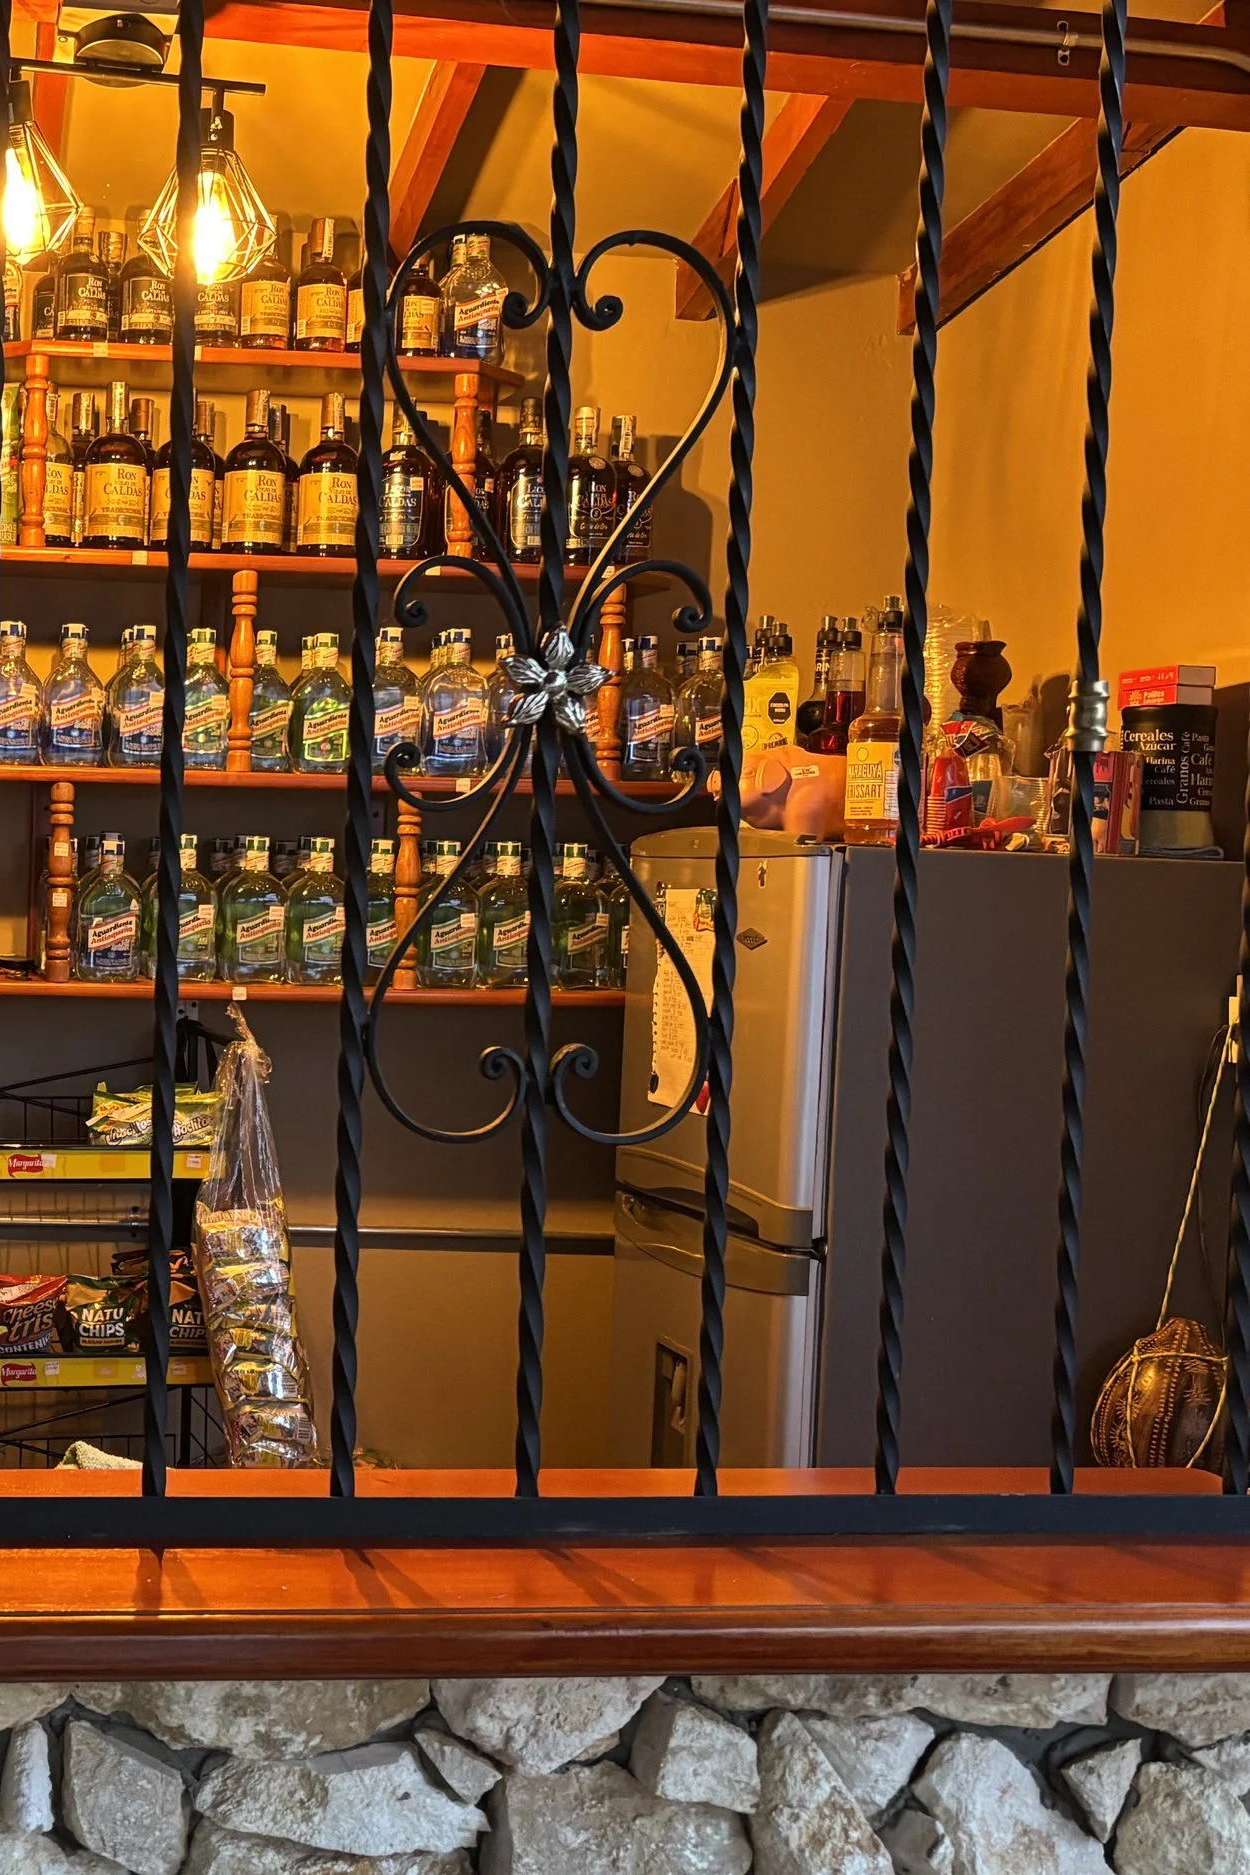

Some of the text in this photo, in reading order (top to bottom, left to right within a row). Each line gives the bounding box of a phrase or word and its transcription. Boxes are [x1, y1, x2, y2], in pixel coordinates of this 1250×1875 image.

[117, 468, 137, 480] RON
[257, 475, 277, 488] RON
[332, 477, 352, 489] RON
[103, 483, 143, 497] CALDAS
[244, 490, 283, 504] CALDAS
[318, 492, 359, 506] CALDAS
[1123, 729, 1174, 742] Cereales
[1140, 741, 1176, 751] Azúcar
[1154, 765, 1176, 774] Café
[1145, 777, 1176, 785] ereales
[1176, 756, 1190, 804] Granos
[92, 920, 132, 938] Aguardiente
[81, 1307, 124, 1322] NATU
[172, 1309, 203, 1325] NAT
[8, 1313, 54, 1342] tris
[79, 1322, 125, 1337] CHIPS
[168, 1326, 205, 1339] CHIP
